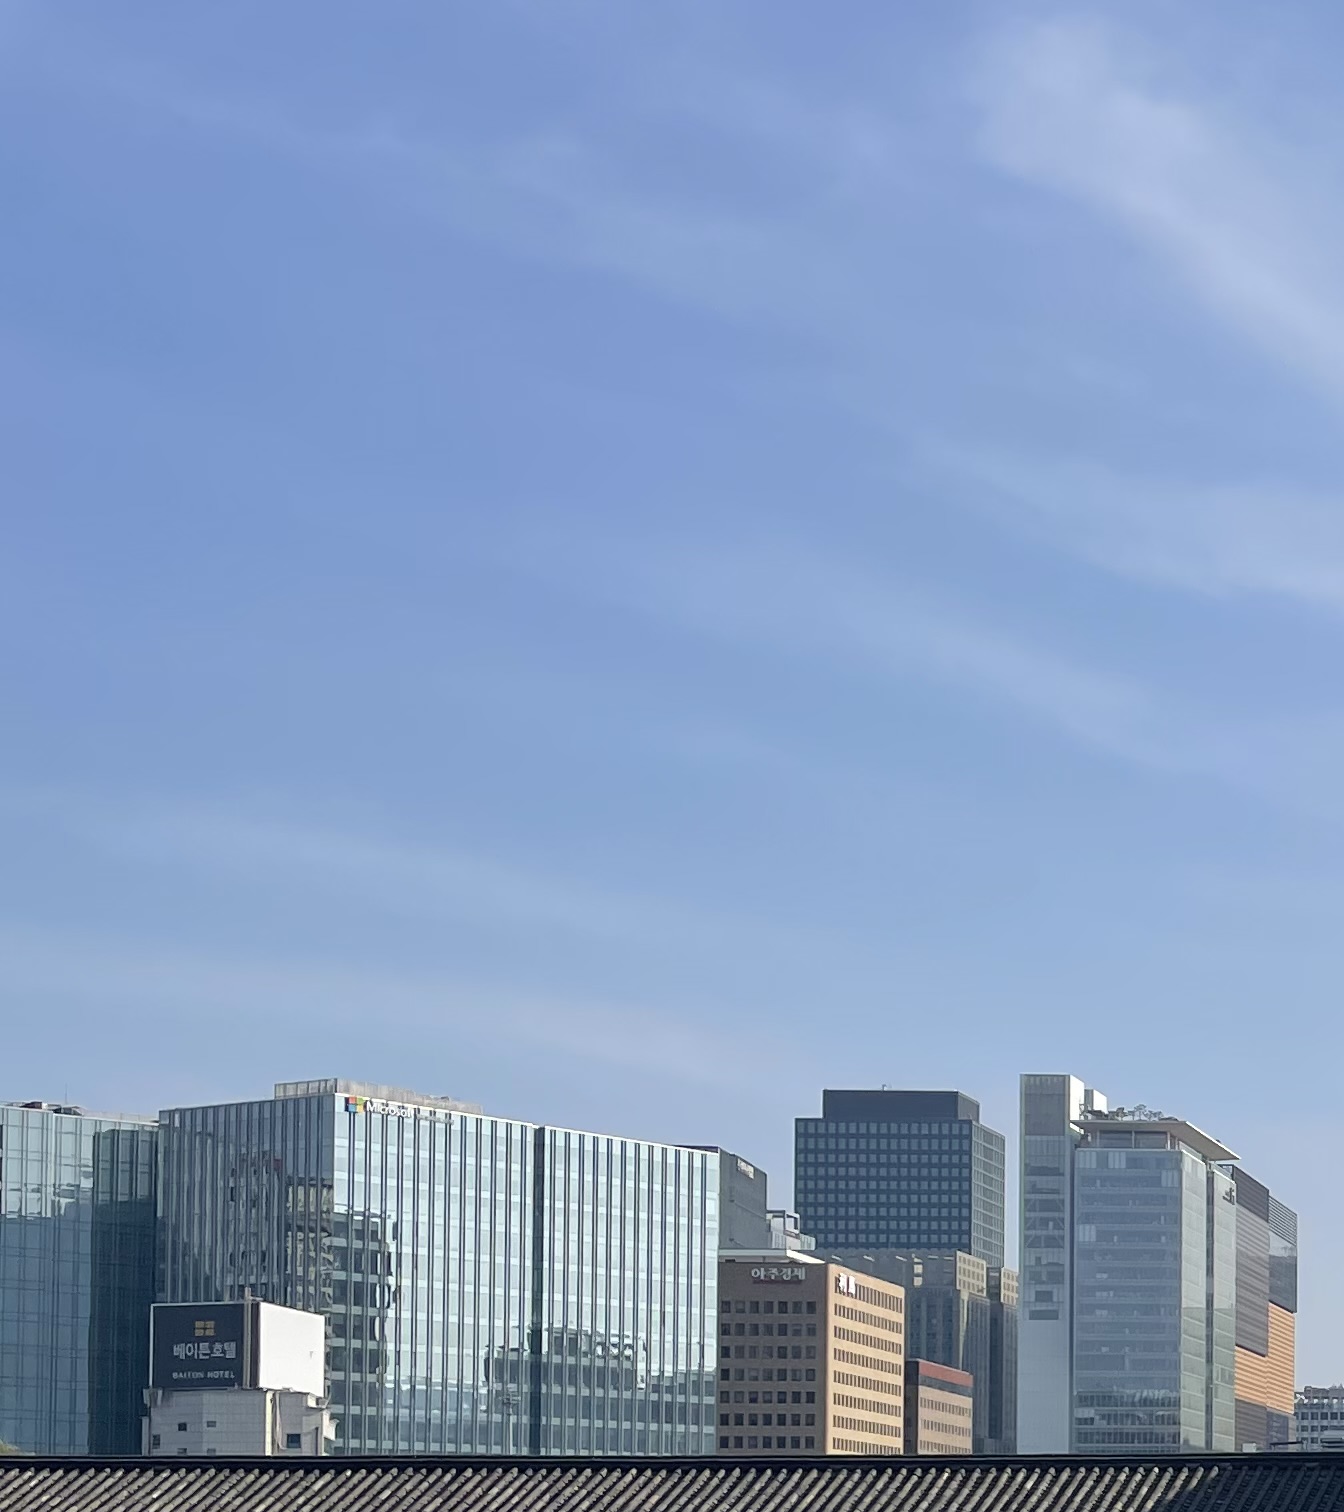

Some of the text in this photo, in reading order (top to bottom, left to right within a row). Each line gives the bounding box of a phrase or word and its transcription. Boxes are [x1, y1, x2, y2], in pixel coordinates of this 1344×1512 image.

[366, 1101, 415, 1118] Microsoft
[751, 1267, 806, 1281] 아주경제
[173, 1341, 236, 1360] 베이튼호텔
[207, 1370, 236, 1379] HOTEL
